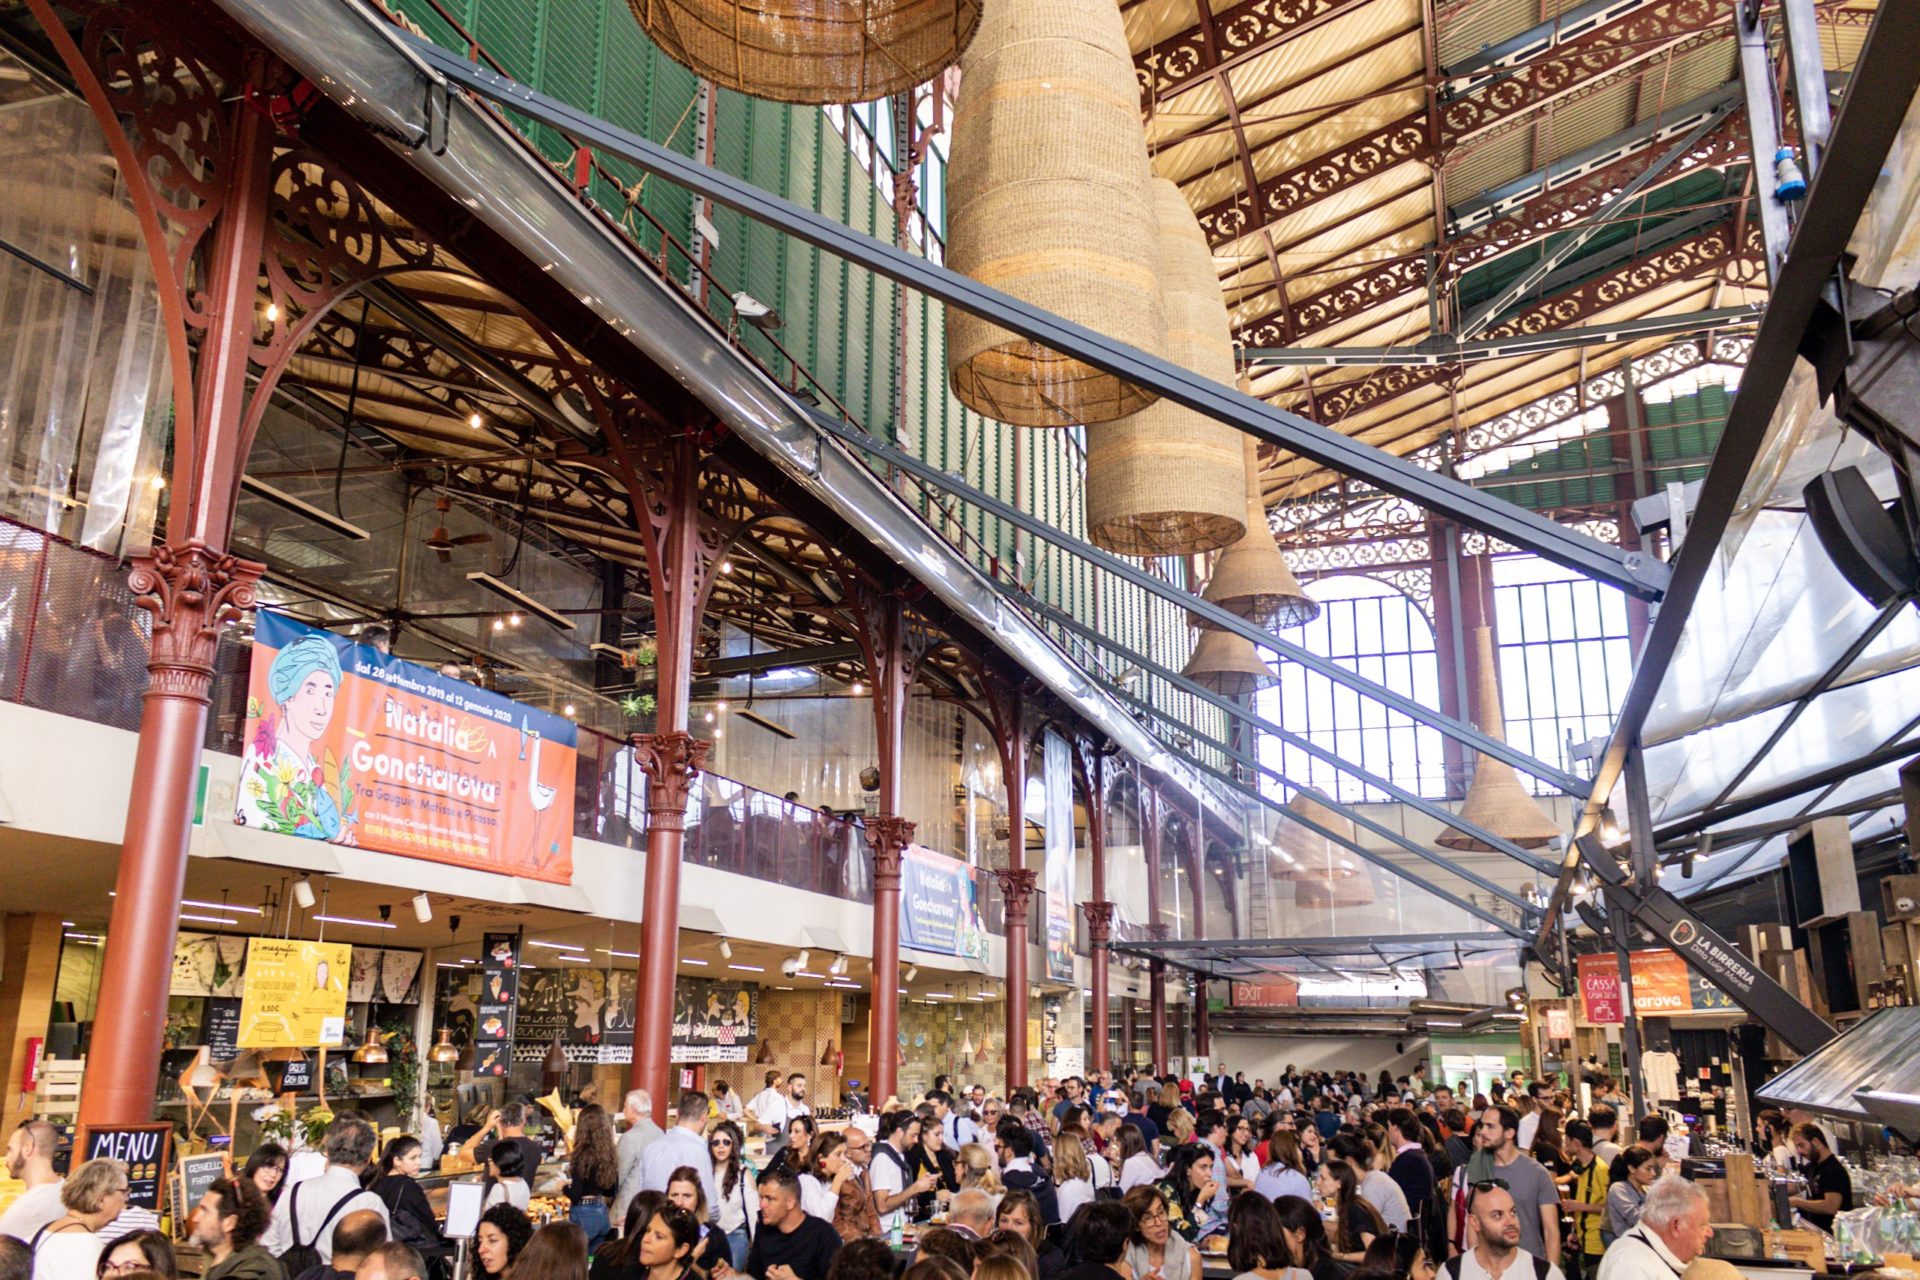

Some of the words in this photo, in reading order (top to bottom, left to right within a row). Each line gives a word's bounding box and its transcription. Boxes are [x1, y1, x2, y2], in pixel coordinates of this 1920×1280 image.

[355, 661, 370, 674] dal
[372, 666, 385, 678] 28
[385, 672, 426, 693] settembre
[426, 685, 445, 700] 2019
[445, 692, 455, 703] al
[455, 695, 464, 707] 12
[463, 699, 493, 717] gennaio
[493, 708, 512, 723] 2020
[385, 698, 469, 750] Natalia
[352, 740, 496, 803] Goncharova
[355, 783, 373, 797] Tra
[420, 799, 455, 817] Matisse
[457, 811, 462, 819] e
[464, 809, 497, 826] Picasso
[912, 893, 954, 918] Goncharova
[1696, 936, 1711, 951] LA
[1709, 946, 1755, 985] BIRRERIA
[1707, 957, 1725, 973] Luigi
[1724, 970, 1752, 993] Moretti
[1238, 985, 1264, 1001] EXIT
[1585, 978, 1617, 991] CASSA
[534, 1027, 567, 1039] CANTA
[93, 1132, 158, 1162] MENU
